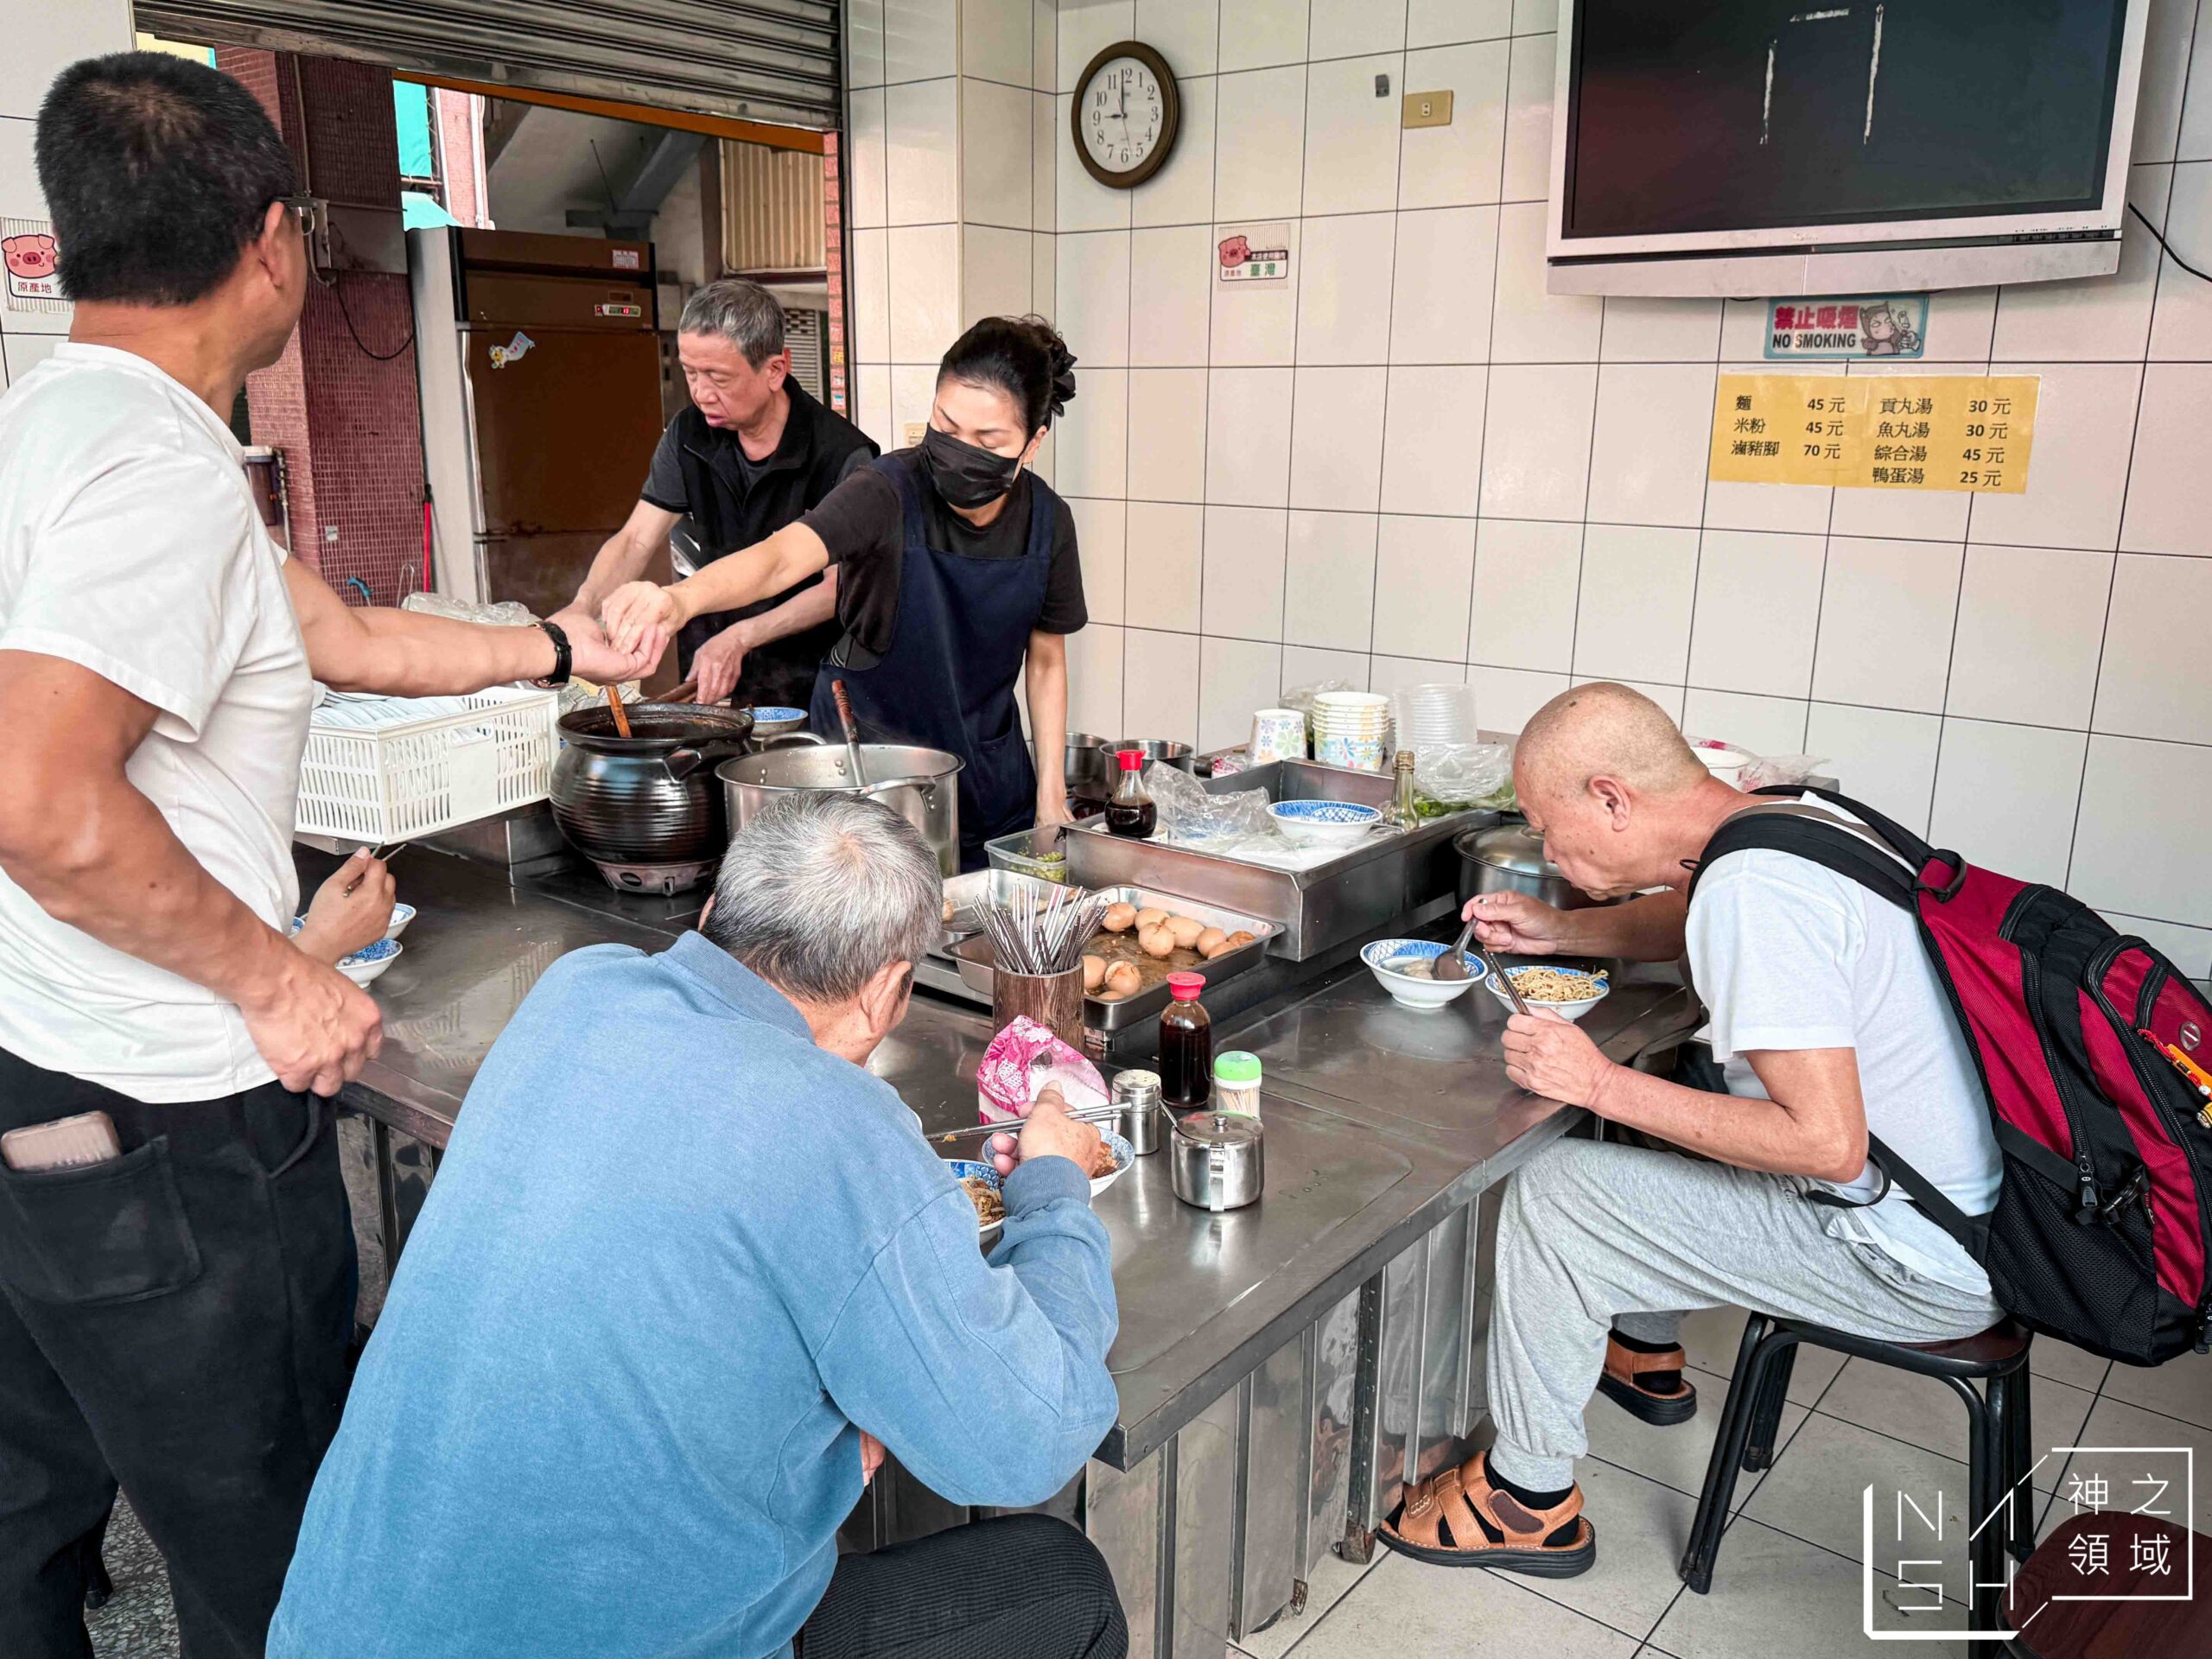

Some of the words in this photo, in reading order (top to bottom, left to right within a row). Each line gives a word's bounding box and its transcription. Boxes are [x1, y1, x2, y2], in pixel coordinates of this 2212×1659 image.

[1108, 74, 1116, 90] 11
[1096, 91, 1107, 106] 10
[1147, 85, 1155, 100] 2
[1093, 111, 1101, 126] 9
[1151, 105, 1159, 122] 3
[1096, 130, 1104, 145] 8
[1145, 126, 1152, 142] 4
[1107, 144, 1114, 159] 7
[1121, 148, 1128, 163] 6
[1135, 143, 1143, 157] 5
[18, 282, 52, 294] 原產地
[1772, 334, 1791, 348] NO
[1795, 333, 1856, 349] SMOKING
[1735, 395, 1752, 410] 麵
[1808, 398, 1824, 410] 45
[1828, 397, 1846, 413] 元
[1879, 397, 1933, 415] 貢丸湯
[1968, 400, 1987, 412] 30
[1991, 397, 2012, 415] 元
[1733, 417, 1766, 434] 米粉
[1806, 422, 1822, 433] 45
[1826, 420, 1844, 436] 元
[1877, 422, 1930, 438] 魚丸湯
[1966, 424, 1985, 436] 30
[1988, 423, 2008, 439] 元
[1804, 445, 1820, 456] 70
[1824, 443, 1841, 460] 元
[1874, 445, 1927, 462] 綜合湯
[1963, 448, 1981, 461] 45
[1986, 447, 2005, 464] 元
[1872, 467, 1925, 484] 鴨蛋湯
[1960, 472, 1978, 483] 25
[1982, 470, 2002, 486] 元
